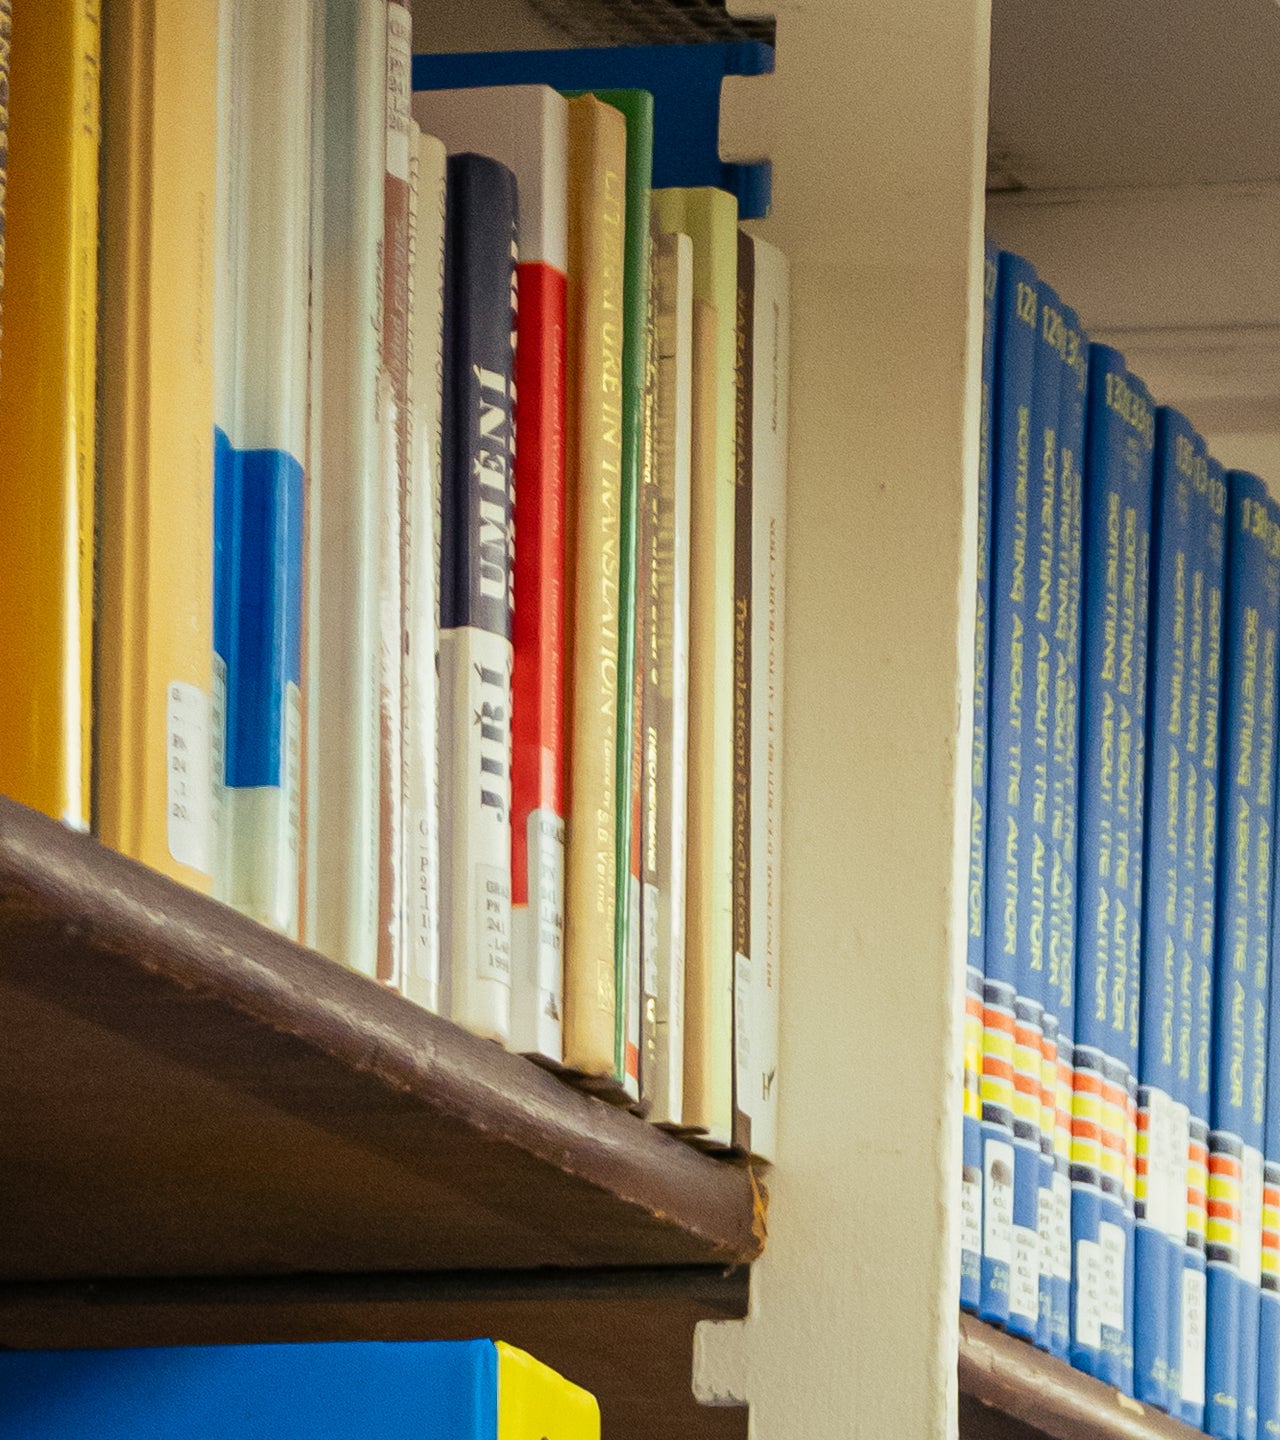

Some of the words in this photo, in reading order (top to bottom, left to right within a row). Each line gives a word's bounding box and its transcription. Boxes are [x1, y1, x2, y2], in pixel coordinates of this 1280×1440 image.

[475, 362, 508, 600] UMĚNÍ
[602, 401, 620, 450] IN
[600, 460, 619, 716] TRANSLATION
[473, 662, 509, 823] JIŘÍ
[734, 786, 750, 956] Touchston
